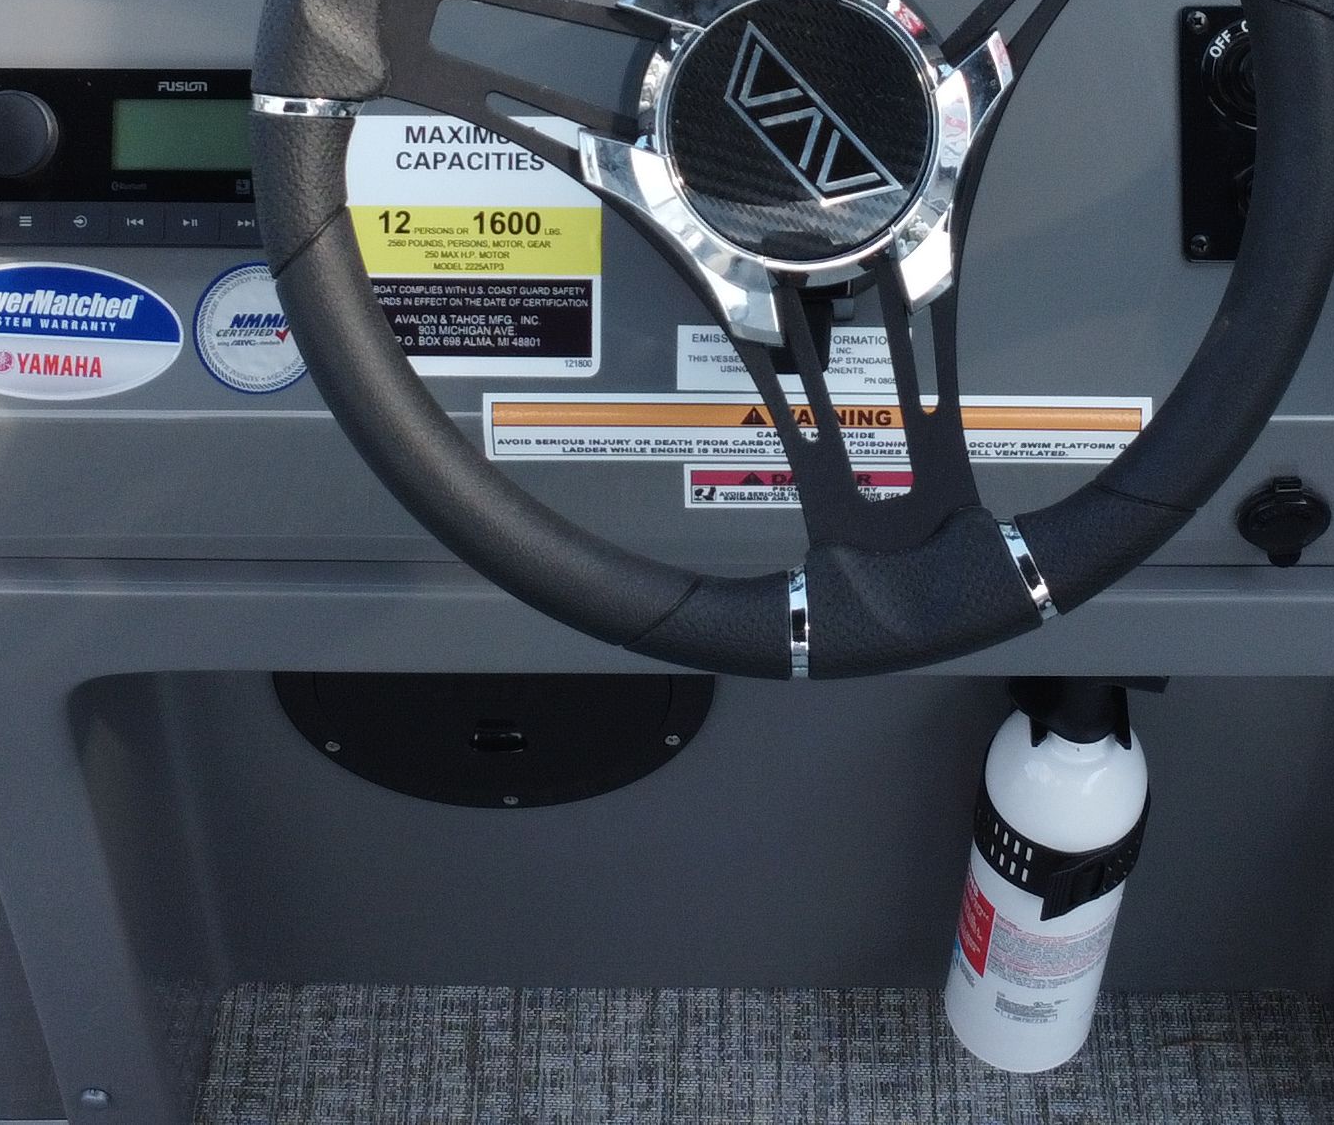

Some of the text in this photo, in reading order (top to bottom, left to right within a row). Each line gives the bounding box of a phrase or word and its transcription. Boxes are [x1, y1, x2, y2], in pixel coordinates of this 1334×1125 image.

[1209, 29, 1232, 59] OFF
[157, 81, 208, 92] FUSION
[405, 125, 509, 144] MAXIM
[396, 151, 545, 171] CAPACITIES
[378, 210, 411, 235] 12
[413, 227, 454, 235] PERSONS
[473, 211, 542, 236] 1600
[544, 228, 562, 236] LBS.
[407, 240, 445, 249] POUNDS,
[447, 240, 490, 249] PERSONS,
[493, 240, 526, 249] MOTOR,
[527, 240, 551, 249] GEAR
[424, 250, 439, 259] 250
[440, 251, 460, 259] MAX
[479, 251, 510, 259] MOTOR
[433, 262, 463, 271] MODEL
[373, 285, 586, 296] BOAT COMPLIES WITH U.S. COAST GUARD SAFETY
[403, 298, 412, 306] IN
[414, 298, 448, 306] EFFECT
[449, 298, 463, 306] ON
[465, 298, 482, 307] THE
[484, 298, 507, 307] DATE
[509, 299, 521, 307] OF
[522, 299, 589, 308] CERTIFICATION
[394, 314, 438, 324] AVALON
[440, 314, 448, 324] &
[449, 315, 486, 324] TAHOE
[520, 315, 542, 325] INC.
[40, 318, 117, 332] WARRANTY
[216, 328, 274, 338] CERTIFIED
[418, 325, 518, 336] 903 MICHIGAN AVE.
[418, 336, 441, 346] BOX
[443, 337, 461, 346] 698
[463, 337, 495, 347] ALMA,
[497, 337, 509, 347] MI
[511, 337, 541, 347] 48801
[691, 333, 730, 343] EMISS
[830, 335, 888, 345] ORMATIO
[688, 355, 743, 363] THIS VESSE
[845, 357, 893, 365] STANDARD
[17, 353, 103, 378] YAMAHA
[826, 366, 867, 375] ONENTS.
[864, 377, 876, 385] PN
[497, 438, 532, 446] AVOID
[535, 438, 585, 446] SERIOUS
[588, 438, 631, 446] INJURY
[696, 439, 729, 447] FROM
[732, 439, 781, 447] CARBON
[849, 440, 907, 448] POISONIN
[969, 441, 1018, 449] OCCUPY
[1055, 442, 1116, 450] PLATFORM
[562, 446, 607, 454] LADDER
[610, 446, 647, 454] WHILE
[713, 447, 770, 455] RUNNING.
[995, 449, 1069, 457] VENTILATED.
